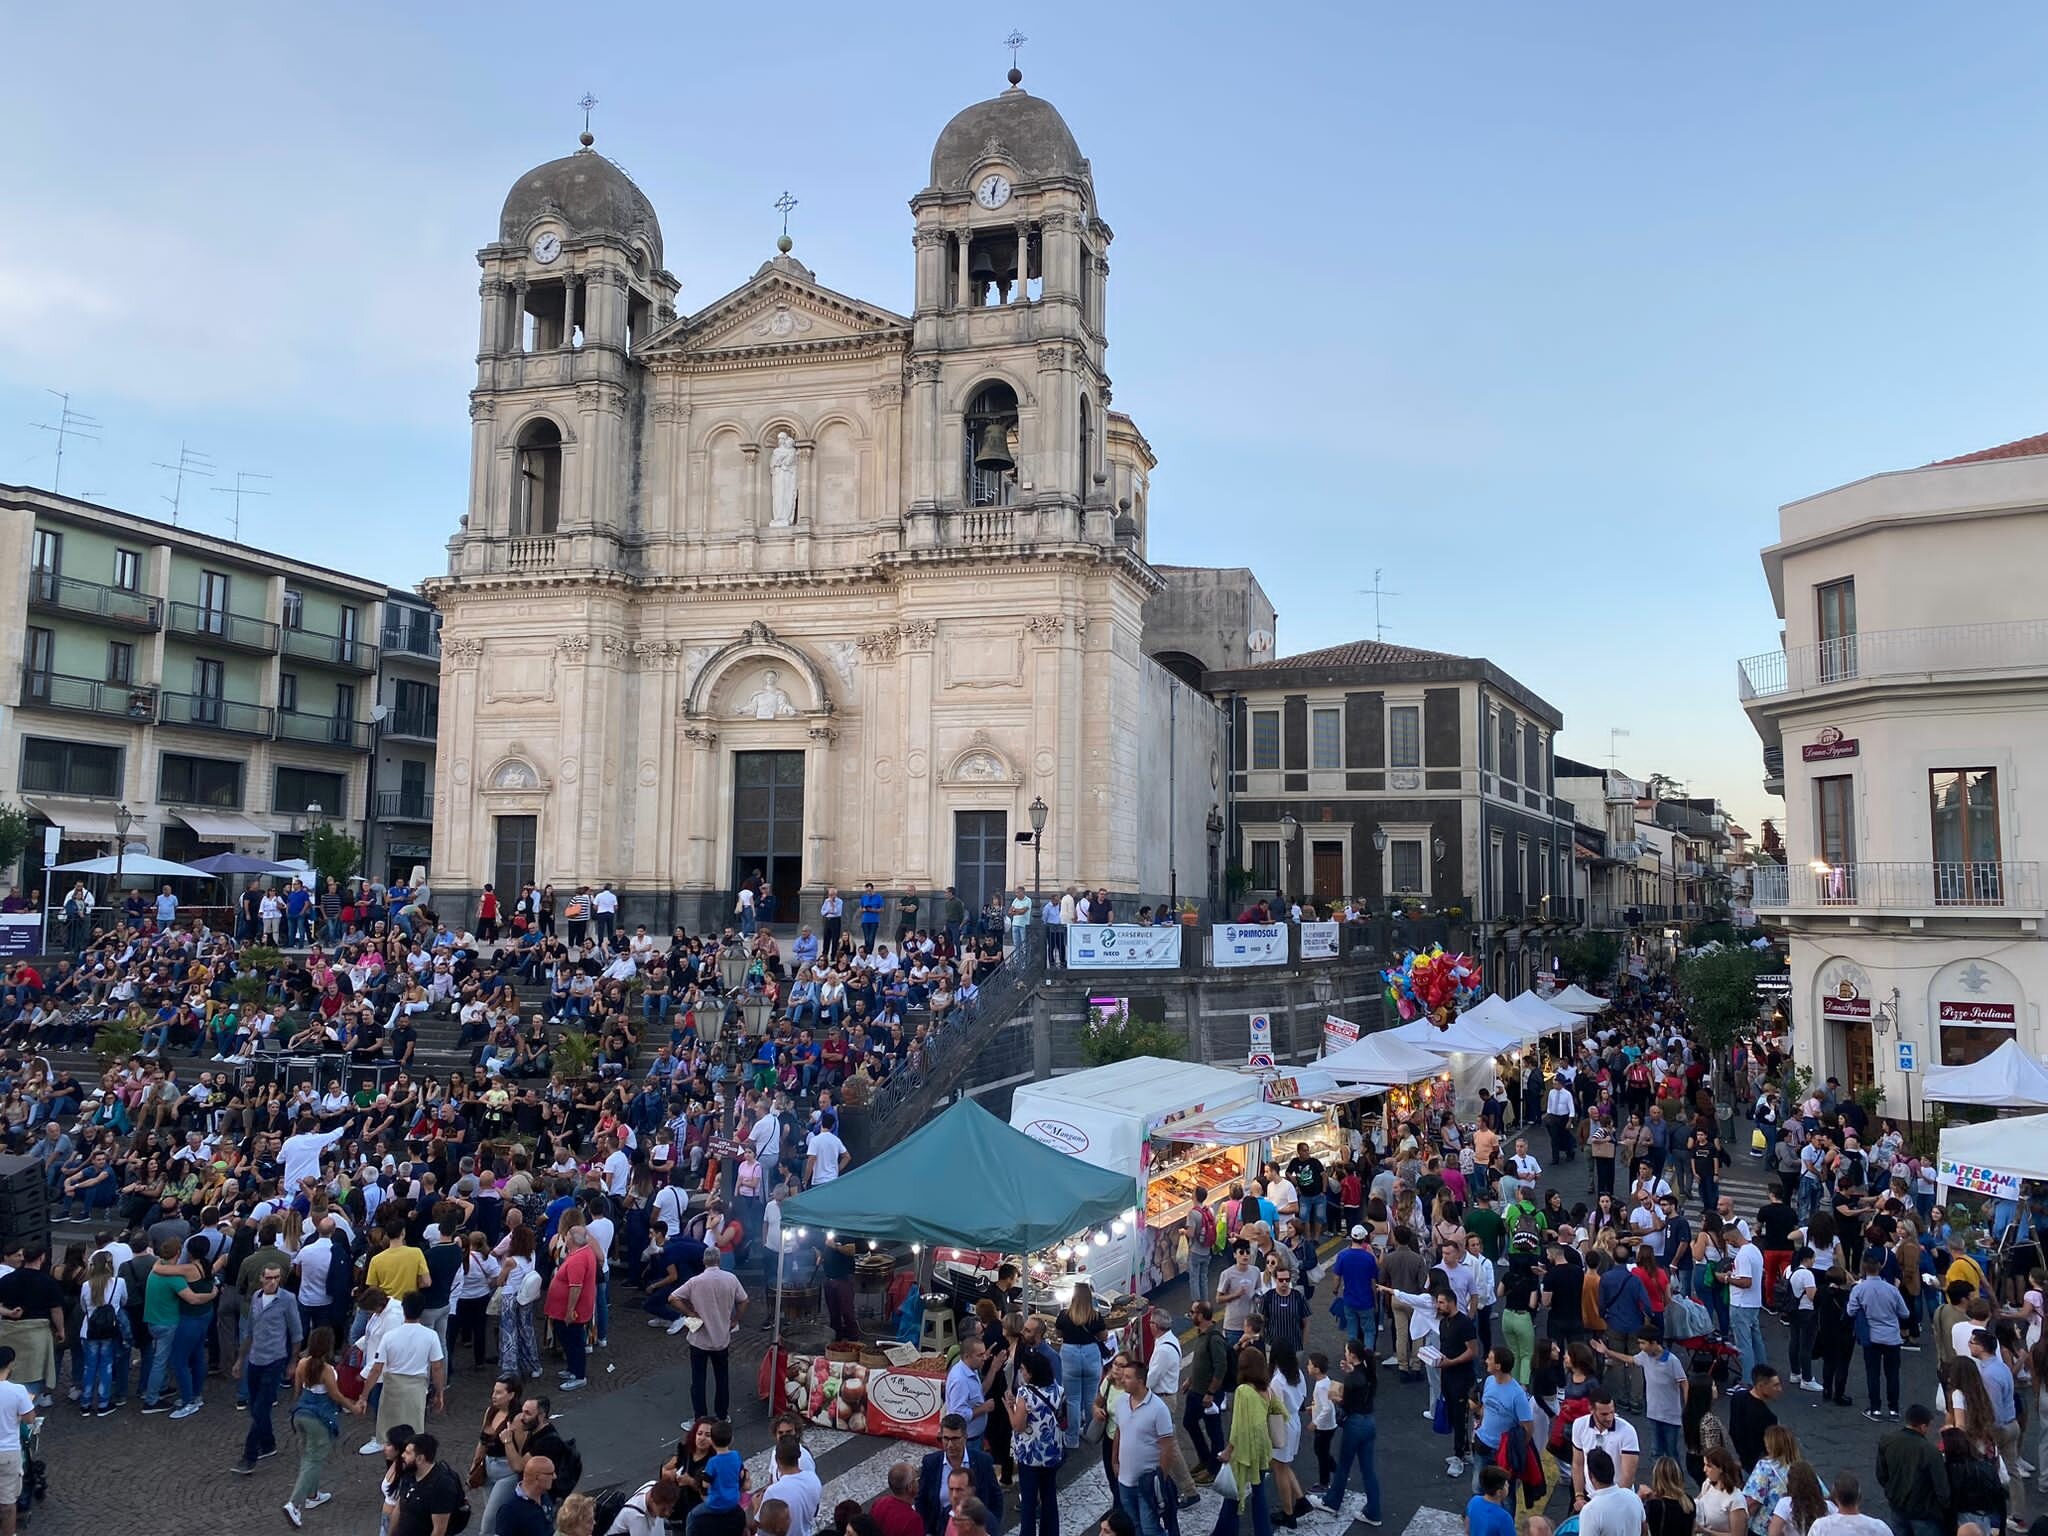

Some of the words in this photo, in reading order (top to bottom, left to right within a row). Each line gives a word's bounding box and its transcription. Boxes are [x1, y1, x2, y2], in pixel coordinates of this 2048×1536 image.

[1238, 929, 1278, 938] PRIMOSOLE
[1970, 1006, 2013, 1019] Siciliane
[1941, 1161, 2017, 1188] ZAFFERANA
[902, 1384, 931, 1398] Mangano
